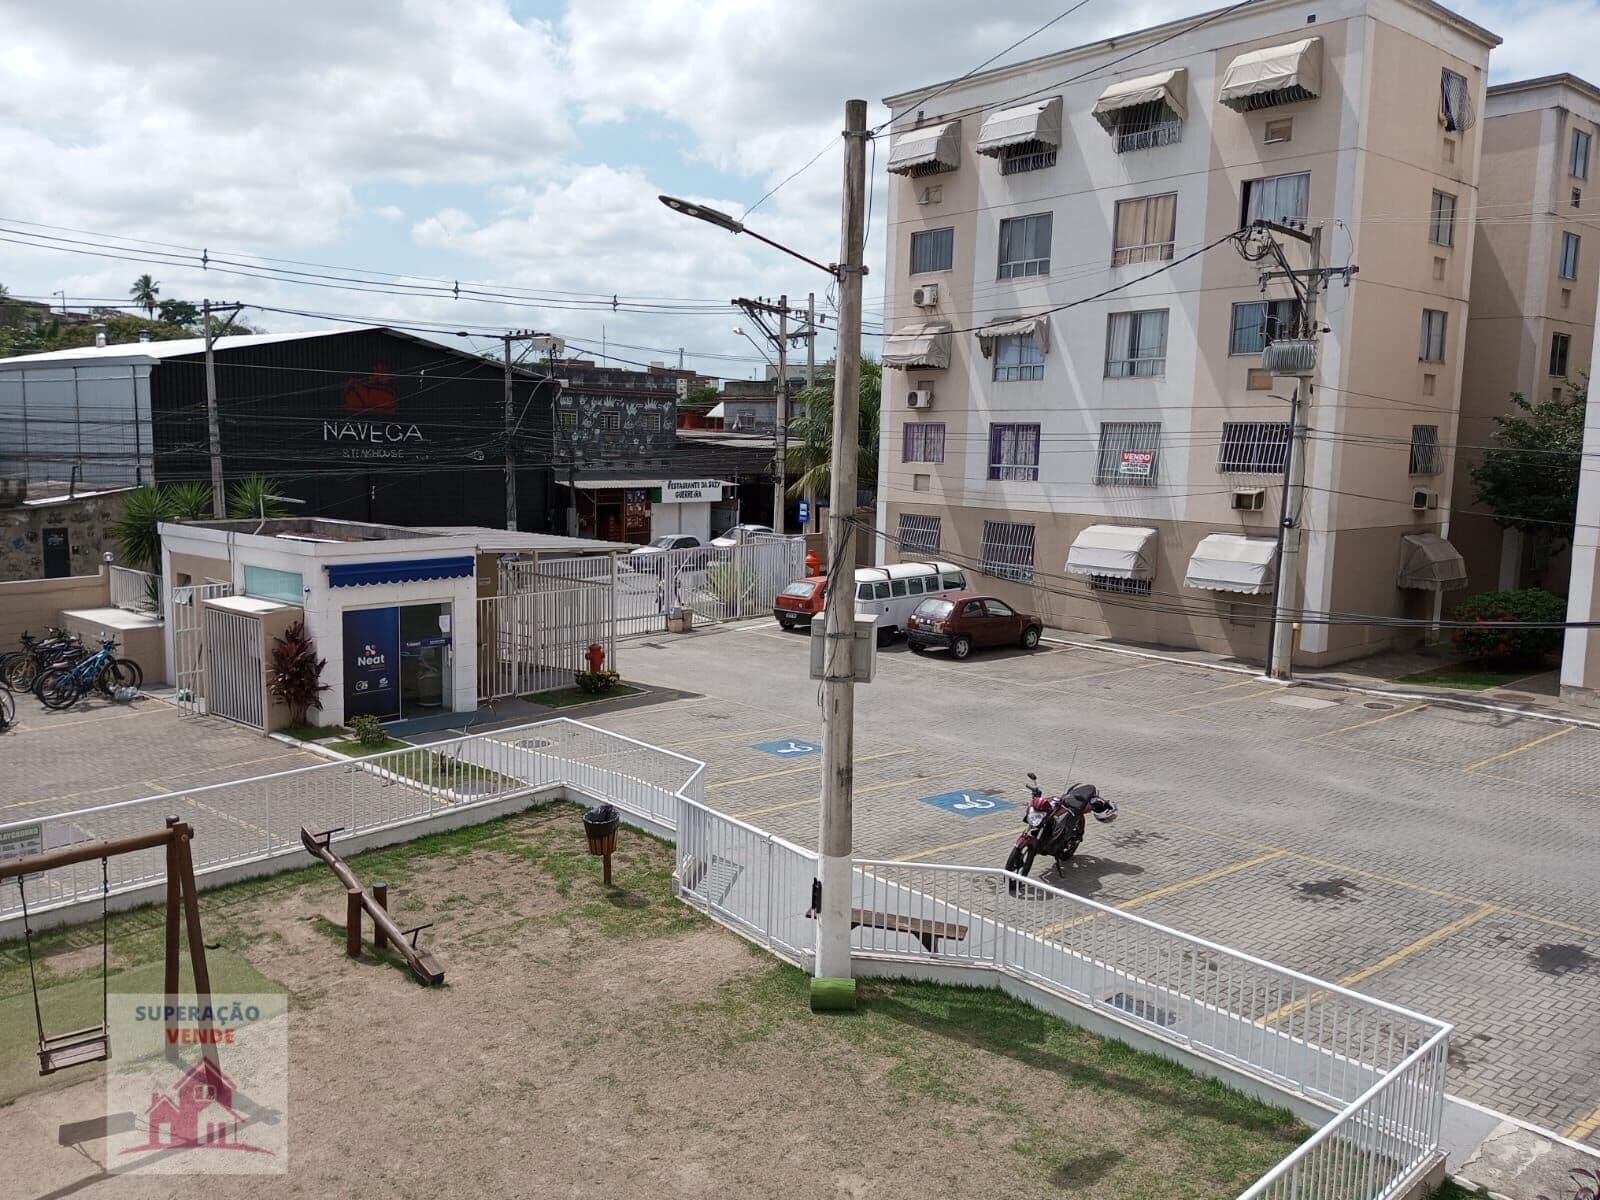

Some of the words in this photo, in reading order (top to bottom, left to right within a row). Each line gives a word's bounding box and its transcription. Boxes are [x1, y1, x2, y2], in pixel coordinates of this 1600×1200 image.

[323, 421, 424, 443] NAVEGA
[342, 448, 404, 458] STEAKHOUSE
[1124, 453, 1150, 461] VENDO
[668, 480, 700, 489] RESTAURANTE
[357, 654, 385, 667] Neat
